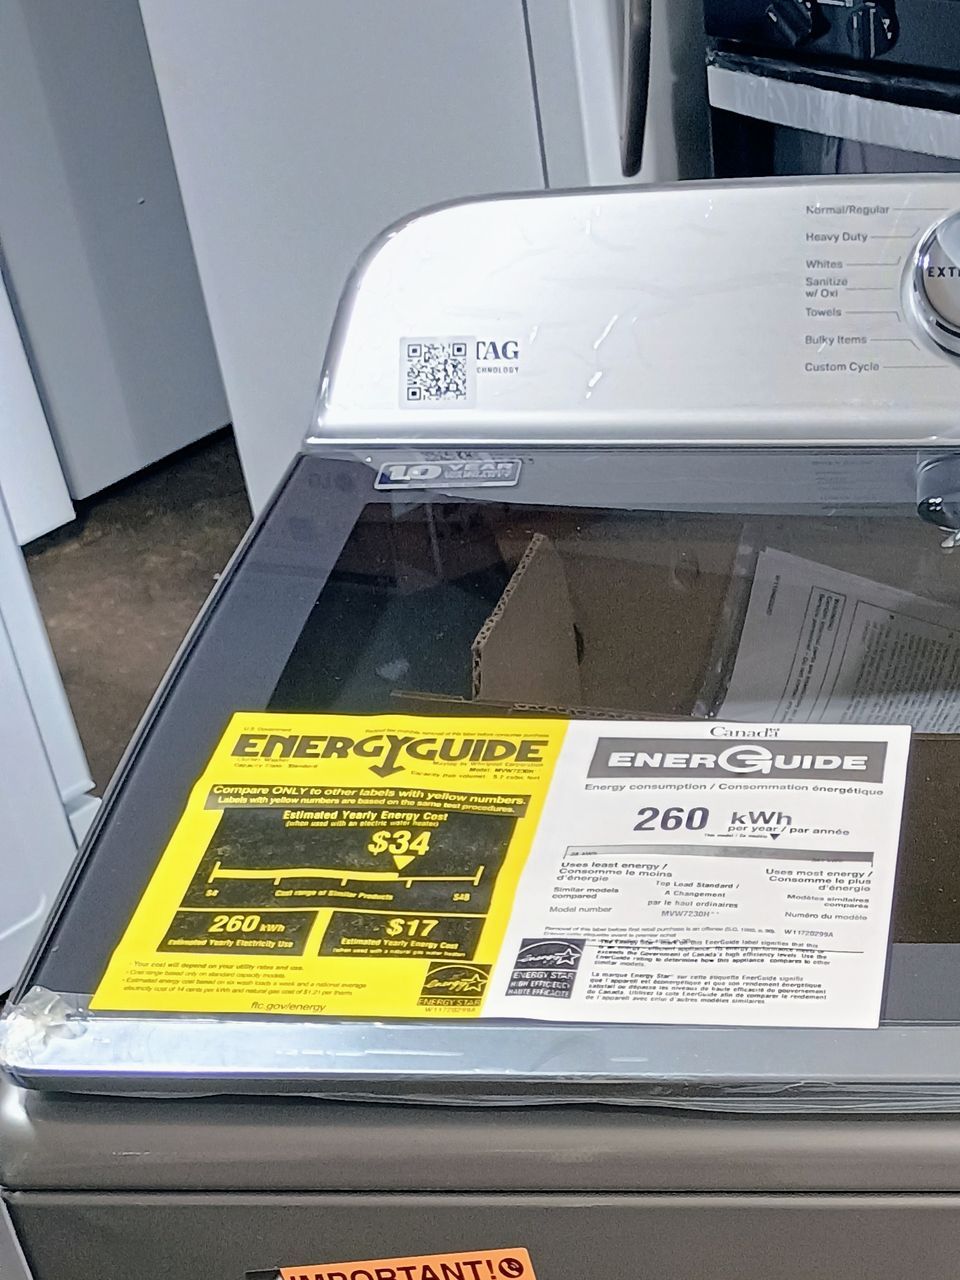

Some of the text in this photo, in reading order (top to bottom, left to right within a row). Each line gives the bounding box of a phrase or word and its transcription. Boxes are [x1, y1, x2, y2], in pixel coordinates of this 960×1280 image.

[806, 205, 890, 216] Normal/Regular
[805, 232, 868, 243] Heavy Duty
[806, 260, 843, 269] Whites
[805, 277, 848, 286] Sanitize
[820, 289, 838, 298] Oxi
[806, 308, 842, 317] Towels
[805, 335, 867, 345] Bulky Items
[477, 341, 518, 360] TAG
[805, 362, 880, 373] Custom Cycle
[389, 465, 441, 480] 10
[709, 726, 780, 737] Canada
[231, 734, 549, 777] ENERGYGUIDE
[608, 744, 869, 774] ENERGUIDE
[213, 785, 527, 806] Compare ONLY to other labels with yellow numbers.
[812, 785, 884, 796] énergétique
[217, 796, 248, 804] Labels
[269, 797, 300, 806] yellow
[357, 798, 386, 806] based
[401, 799, 415, 807] the
[416, 800, 442, 808] same
[443, 801, 461, 809] test
[462, 803, 515, 814] procedures.
[283, 810, 449, 824] Estimated Yearly Energy Cost
[633, 807, 709, 831] 260
[730, 811, 792, 825] kWh
[367, 830, 432, 856] $34
[621, 863, 659, 871] energy
[208, 915, 285, 932] 260 kWh
[386, 918, 439, 937] $17
[341, 938, 381, 946] Estimated
[410, 941, 438, 949] Energy
